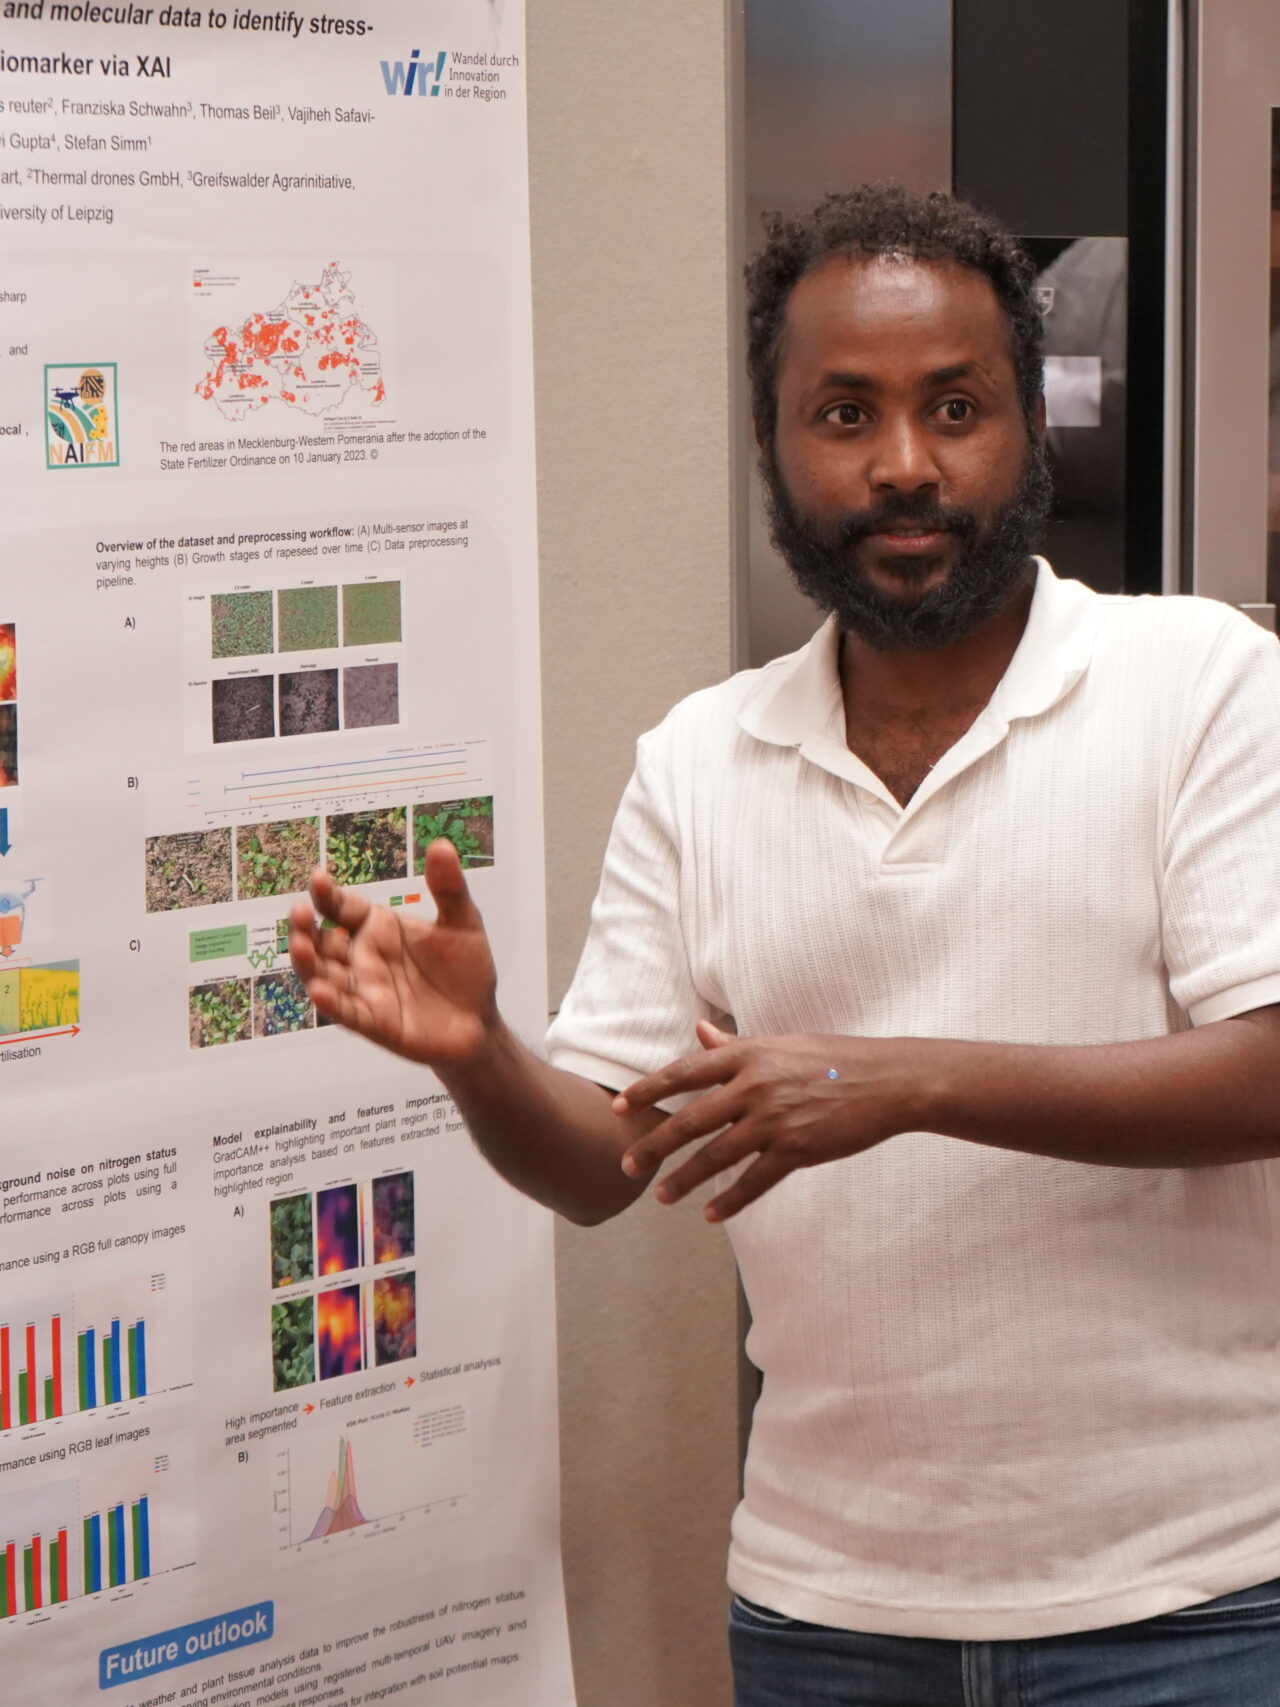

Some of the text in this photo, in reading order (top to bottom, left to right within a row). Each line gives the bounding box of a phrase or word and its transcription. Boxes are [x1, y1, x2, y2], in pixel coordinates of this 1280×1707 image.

[3, 0, 374, 38] and molecular data to identify stress-
[100, 54, 129, 77] via
[136, 55, 171, 78] XAI
[451, 51, 519, 66] Wandel durch
[380, 49, 447, 97] wir!
[449, 68, 499, 82] Innovation
[444, 85, 506, 102] in der Region
[62, 98, 375, 125] Franziska Thomas Vajiheh Safavi-
[64, 134, 107, 150] Stefan
[91, 170, 355, 192] drones GmbH, Agrarinitiative,
[51, 204, 65, 220] of
[67, 205, 113, 225] Leipzig
[9, 344, 28, 356] and
[50, 441, 113, 465] NAIFM
[160, 428, 486, 453] The red areas in Mecklenburg-Western Pomerania after the adoption of the
[160, 450, 341, 470] State Fertilizer Ordinance on 10 January
[96, 519, 468, 553] Overview of the dataset and preprocessing workflow: (A) Multi-sensor images at
[96, 536, 468, 573] varying heights (B) Growth stages of rapeseed over time (C) Data preprocessing
[124, 616, 136, 630] A)
[127, 776, 139, 790] B)
[129, 939, 141, 953] C)
[213, 1103, 394, 1147] Model explainability and features
[213, 1145, 269, 1163] GradCAM++
[275, 1133, 325, 1152] highlighting
[330, 1123, 370, 1140] important
[375, 1118, 397, 1133] plant
[401, 1111, 428, 1127] region
[433, 1107, 446, 1122] (B)
[46, 1146, 177, 1182] noise on nitrogen status
[213, 1121, 465, 1180] importance analysis based on features extracted from
[3, 1161, 177, 1209] performance across plots using full
[61, 1183, 162, 1213] across plots using
[214, 1178, 263, 1198] highlighted
[265, 1171, 293, 1186] region
[233, 1205, 244, 1218] A)
[33, 1223, 186, 1265] using RGB full canopy images
[420, 1356, 502, 1383] Statistical analysis
[319, 1381, 396, 1410] Feature extraction
[225, 1402, 299, 1430] High importance
[39, 1426, 150, 1463] using RGB leaf images
[225, 1417, 298, 1446] area segmented
[238, 1450, 249, 1463] B)
[106, 1610, 268, 1680] Future outlook
[180, 1589, 525, 1698] and plant tissue analysis data to improve the robustness of nitrogen status
[256, 1687, 289, 1706] models
[294, 1678, 318, 1694] using
[323, 1662, 367, 1685] registered
[371, 1642, 431, 1669] multi-temporal
[435, 1633, 456, 1649] UAV
[461, 1626, 502, 1642] imagery
[507, 1618, 527, 1632] and
[210, 1675, 274, 1704] environmental
[351, 1695, 362, 1707] for
[364, 1680, 408, 1703] integration
[410, 1674, 426, 1687] with
[428, 1667, 444, 1682] soil
[446, 1657, 488, 1677] potential
